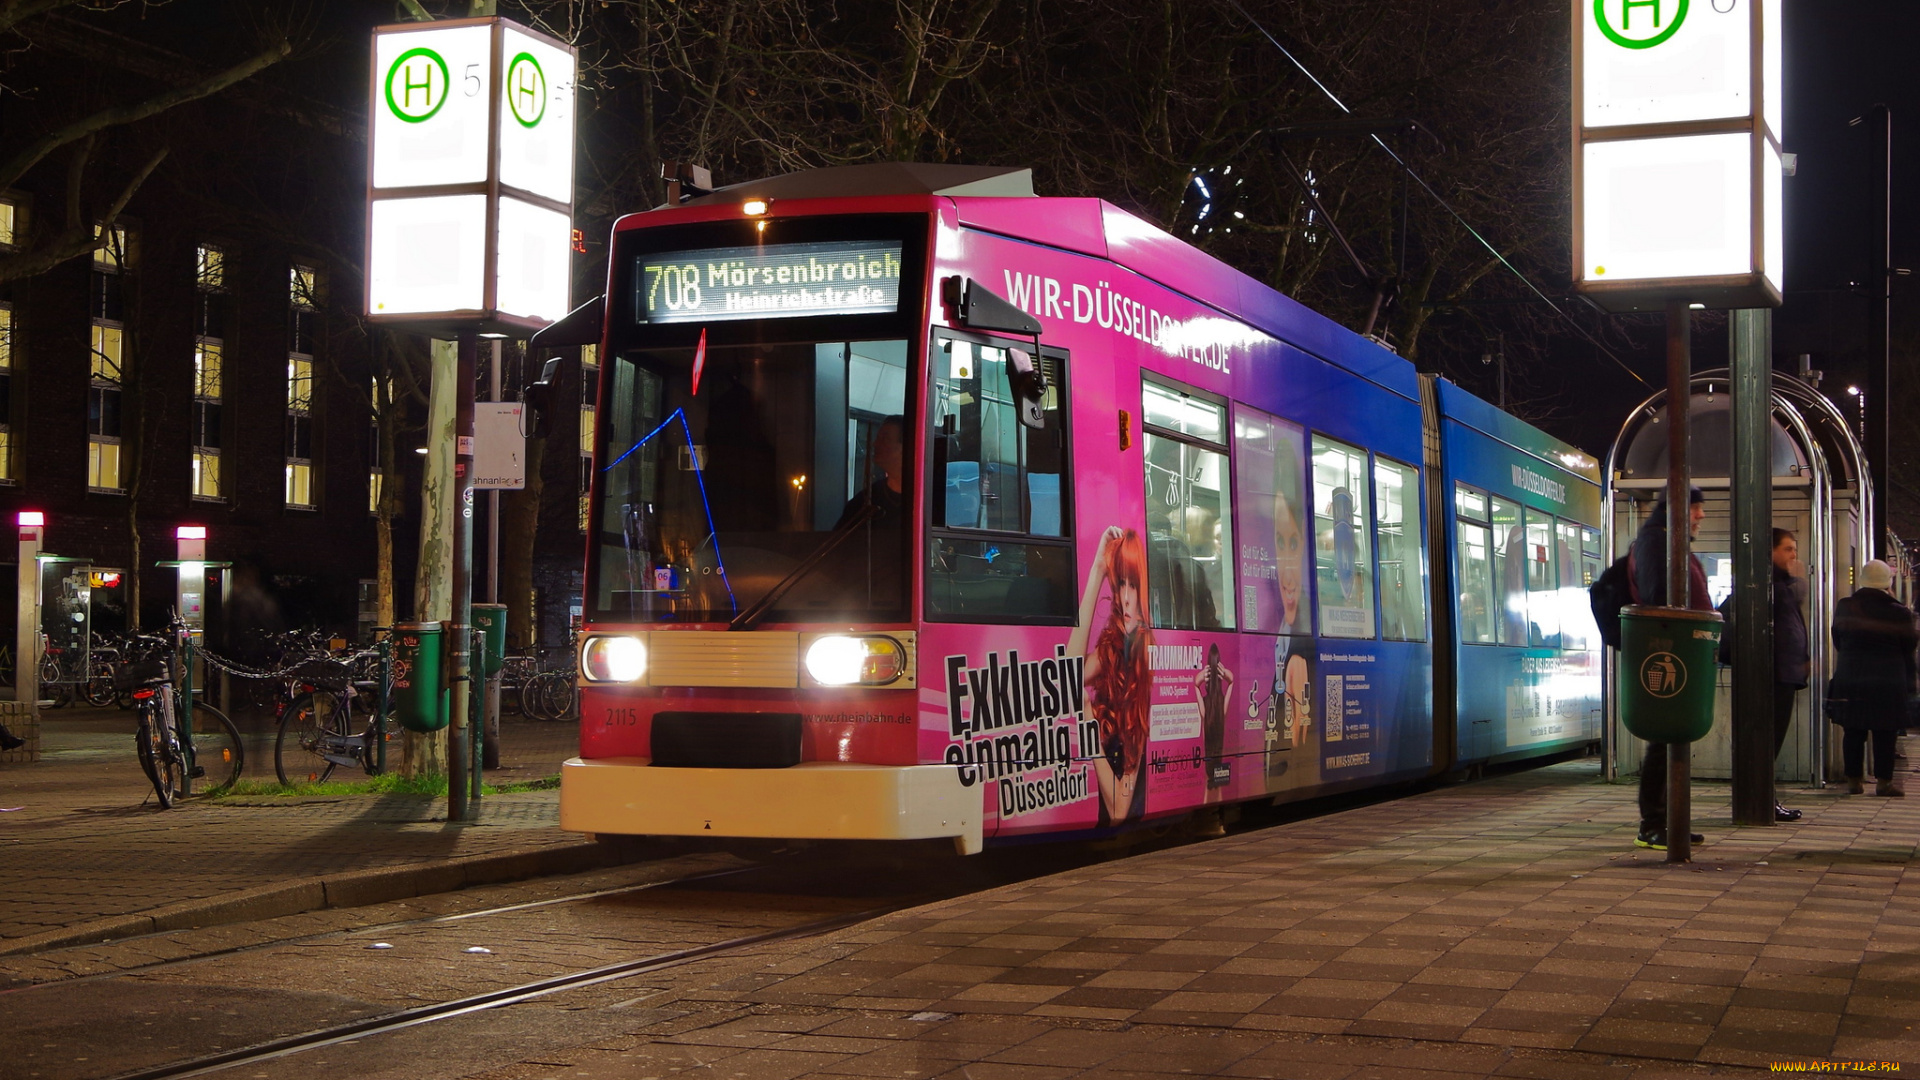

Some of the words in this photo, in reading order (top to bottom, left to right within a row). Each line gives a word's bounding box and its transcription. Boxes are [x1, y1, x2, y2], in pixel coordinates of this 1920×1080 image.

[464, 63, 480, 97] 5
[708, 254, 900, 288] Mörsenbroich
[645, 265, 701, 312] 708
[726, 285, 884, 311] Heinrichstraße
[1743, 533, 1749, 543] 5
[1243, 562, 1252, 577] Gut
[1148, 645, 1202, 670] TRAUMHAARE
[947, 645, 1083, 736] Exklusiv
[606, 708, 636, 726] 2115
[802, 712, 912, 725] www.rheinbahn.de
[946, 717, 1070, 787] einmalig
[1078, 713, 1100, 758] in
[1000, 766, 1087, 816] Düsseldorf
